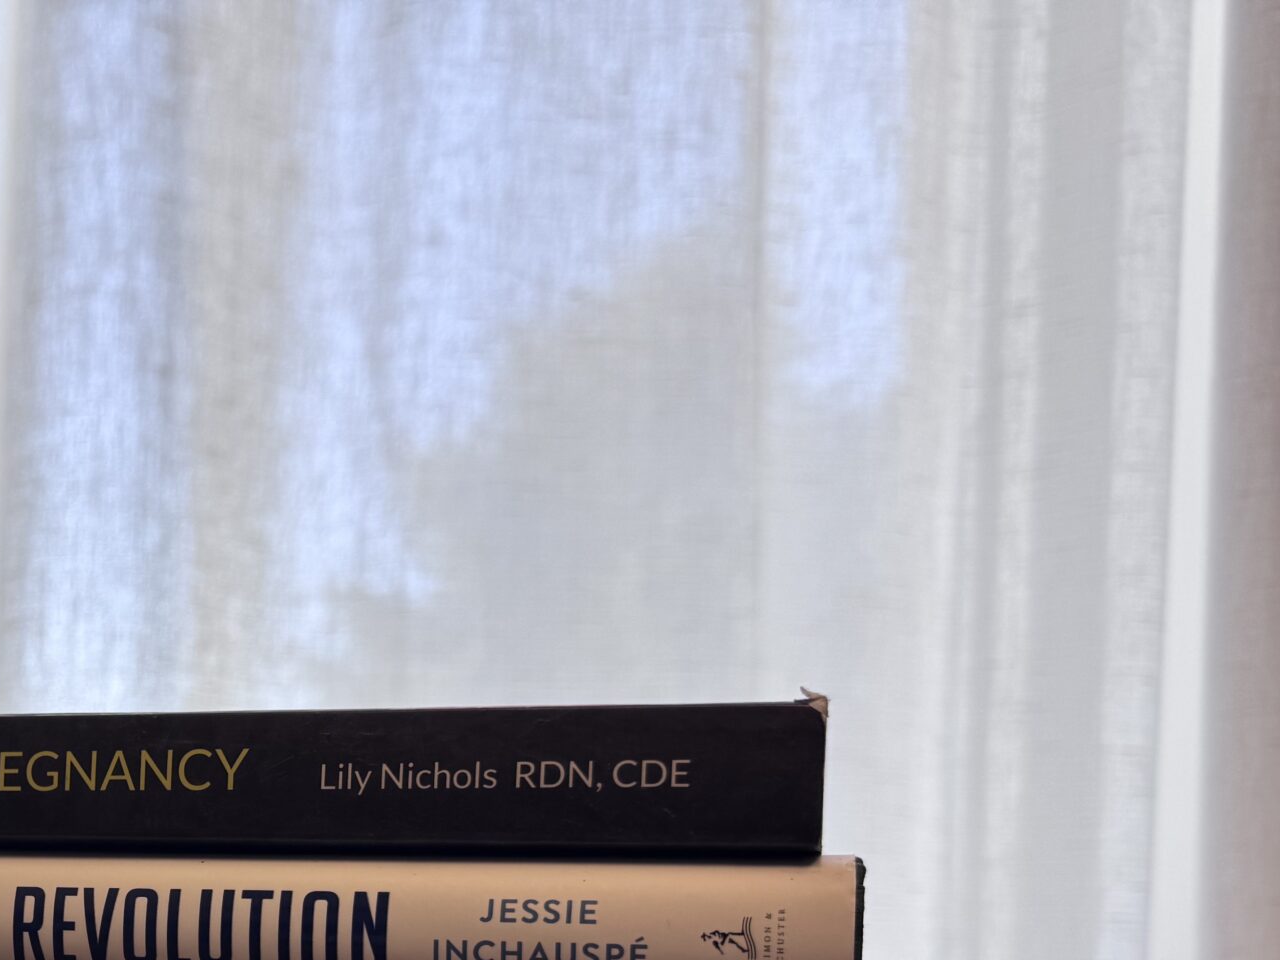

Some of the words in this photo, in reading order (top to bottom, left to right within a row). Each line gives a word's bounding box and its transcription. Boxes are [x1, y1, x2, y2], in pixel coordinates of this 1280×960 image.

[320, 762, 373, 796] Lily
[381, 761, 498, 791] Nichols
[515, 760, 604, 793] RDN,
[612, 758, 691, 790] CDE
[479, 898, 599, 926] JESSIE
